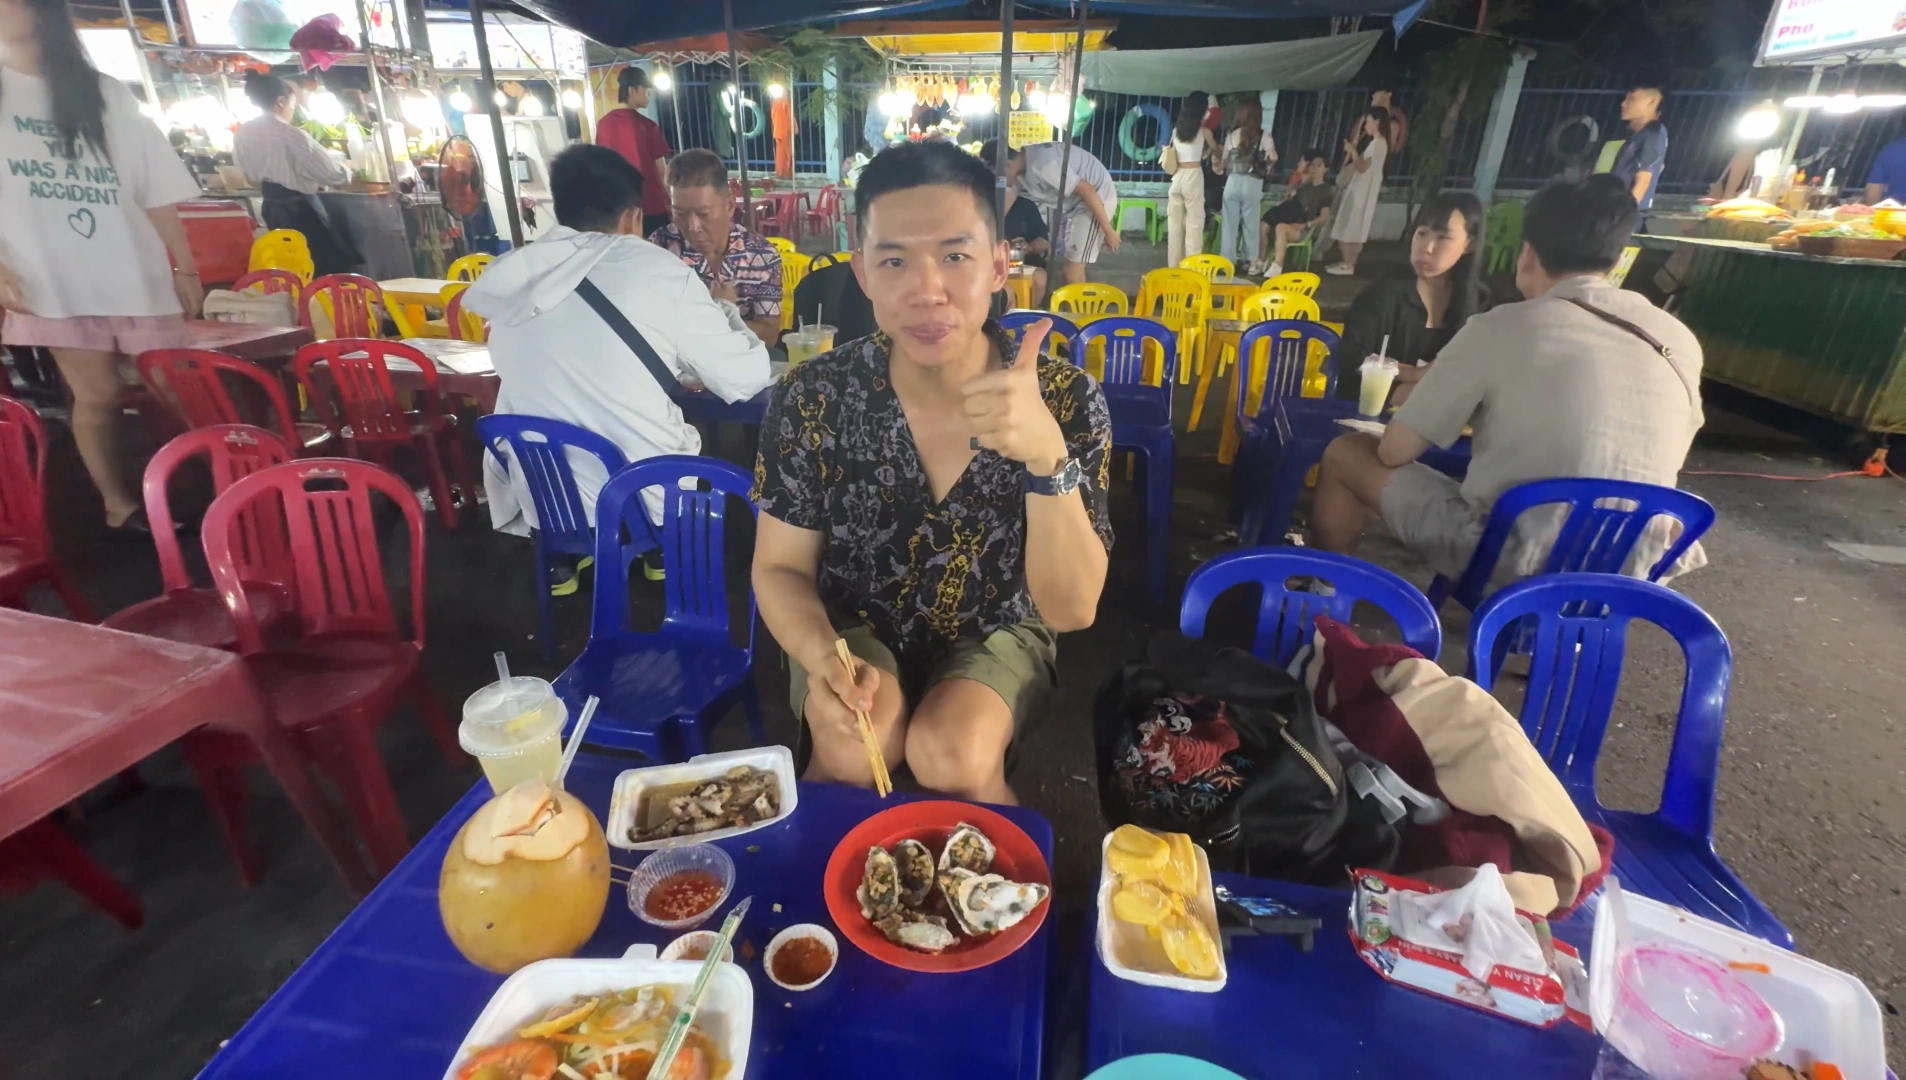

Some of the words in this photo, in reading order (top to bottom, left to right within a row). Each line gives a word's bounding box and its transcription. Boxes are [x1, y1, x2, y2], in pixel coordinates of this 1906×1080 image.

[7, 158, 56, 179] WAS
[65, 163, 79, 180] A
[30, 181, 119, 206] ACCIDENT
